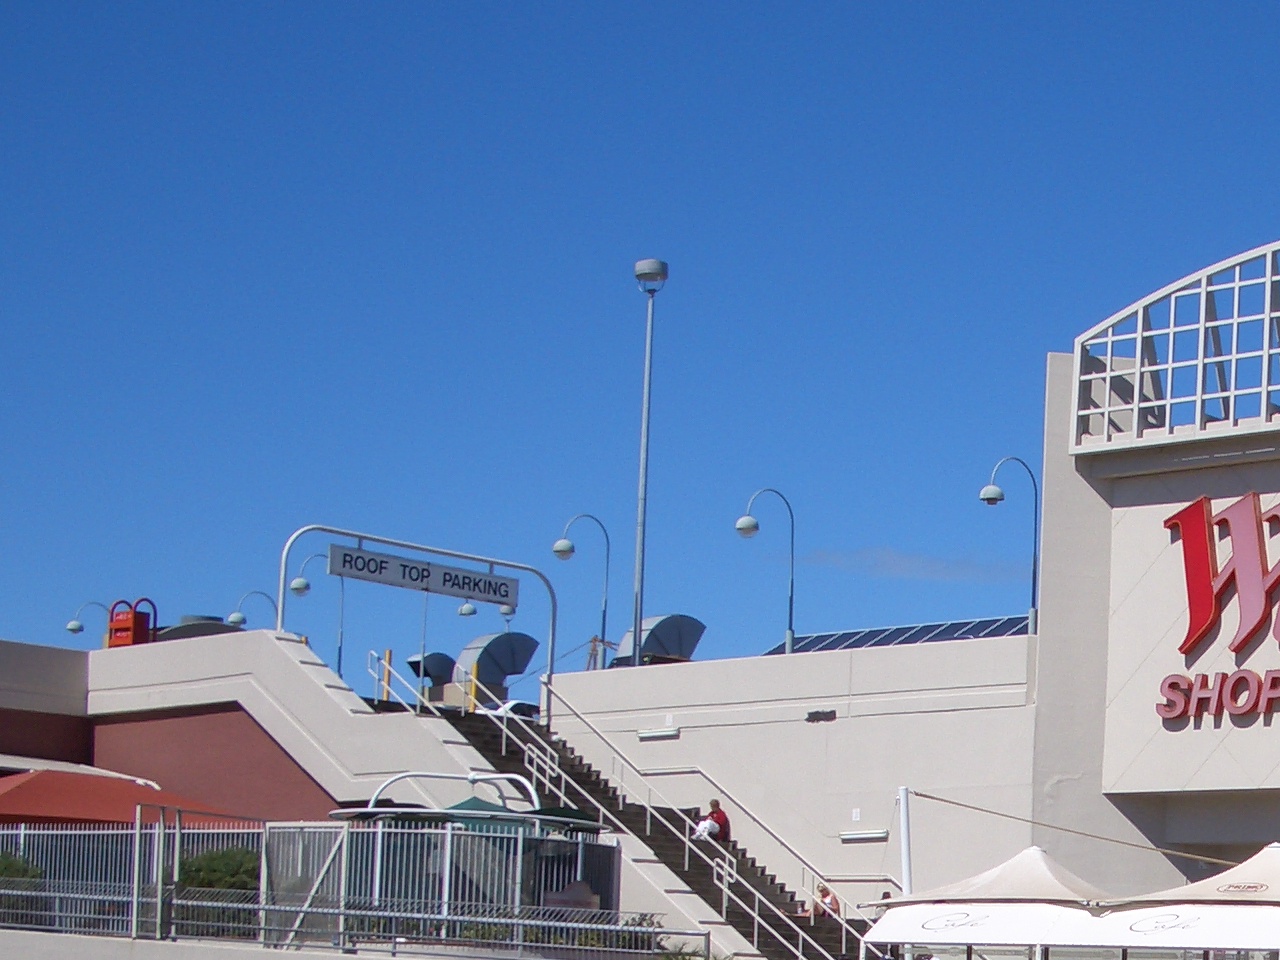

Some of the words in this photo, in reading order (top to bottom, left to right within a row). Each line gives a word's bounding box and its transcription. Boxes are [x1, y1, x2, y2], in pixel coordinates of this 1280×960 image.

[342, 553, 388, 575] ROOF
[400, 563, 431, 583] TOP
[443, 572, 509, 598] PARKING
